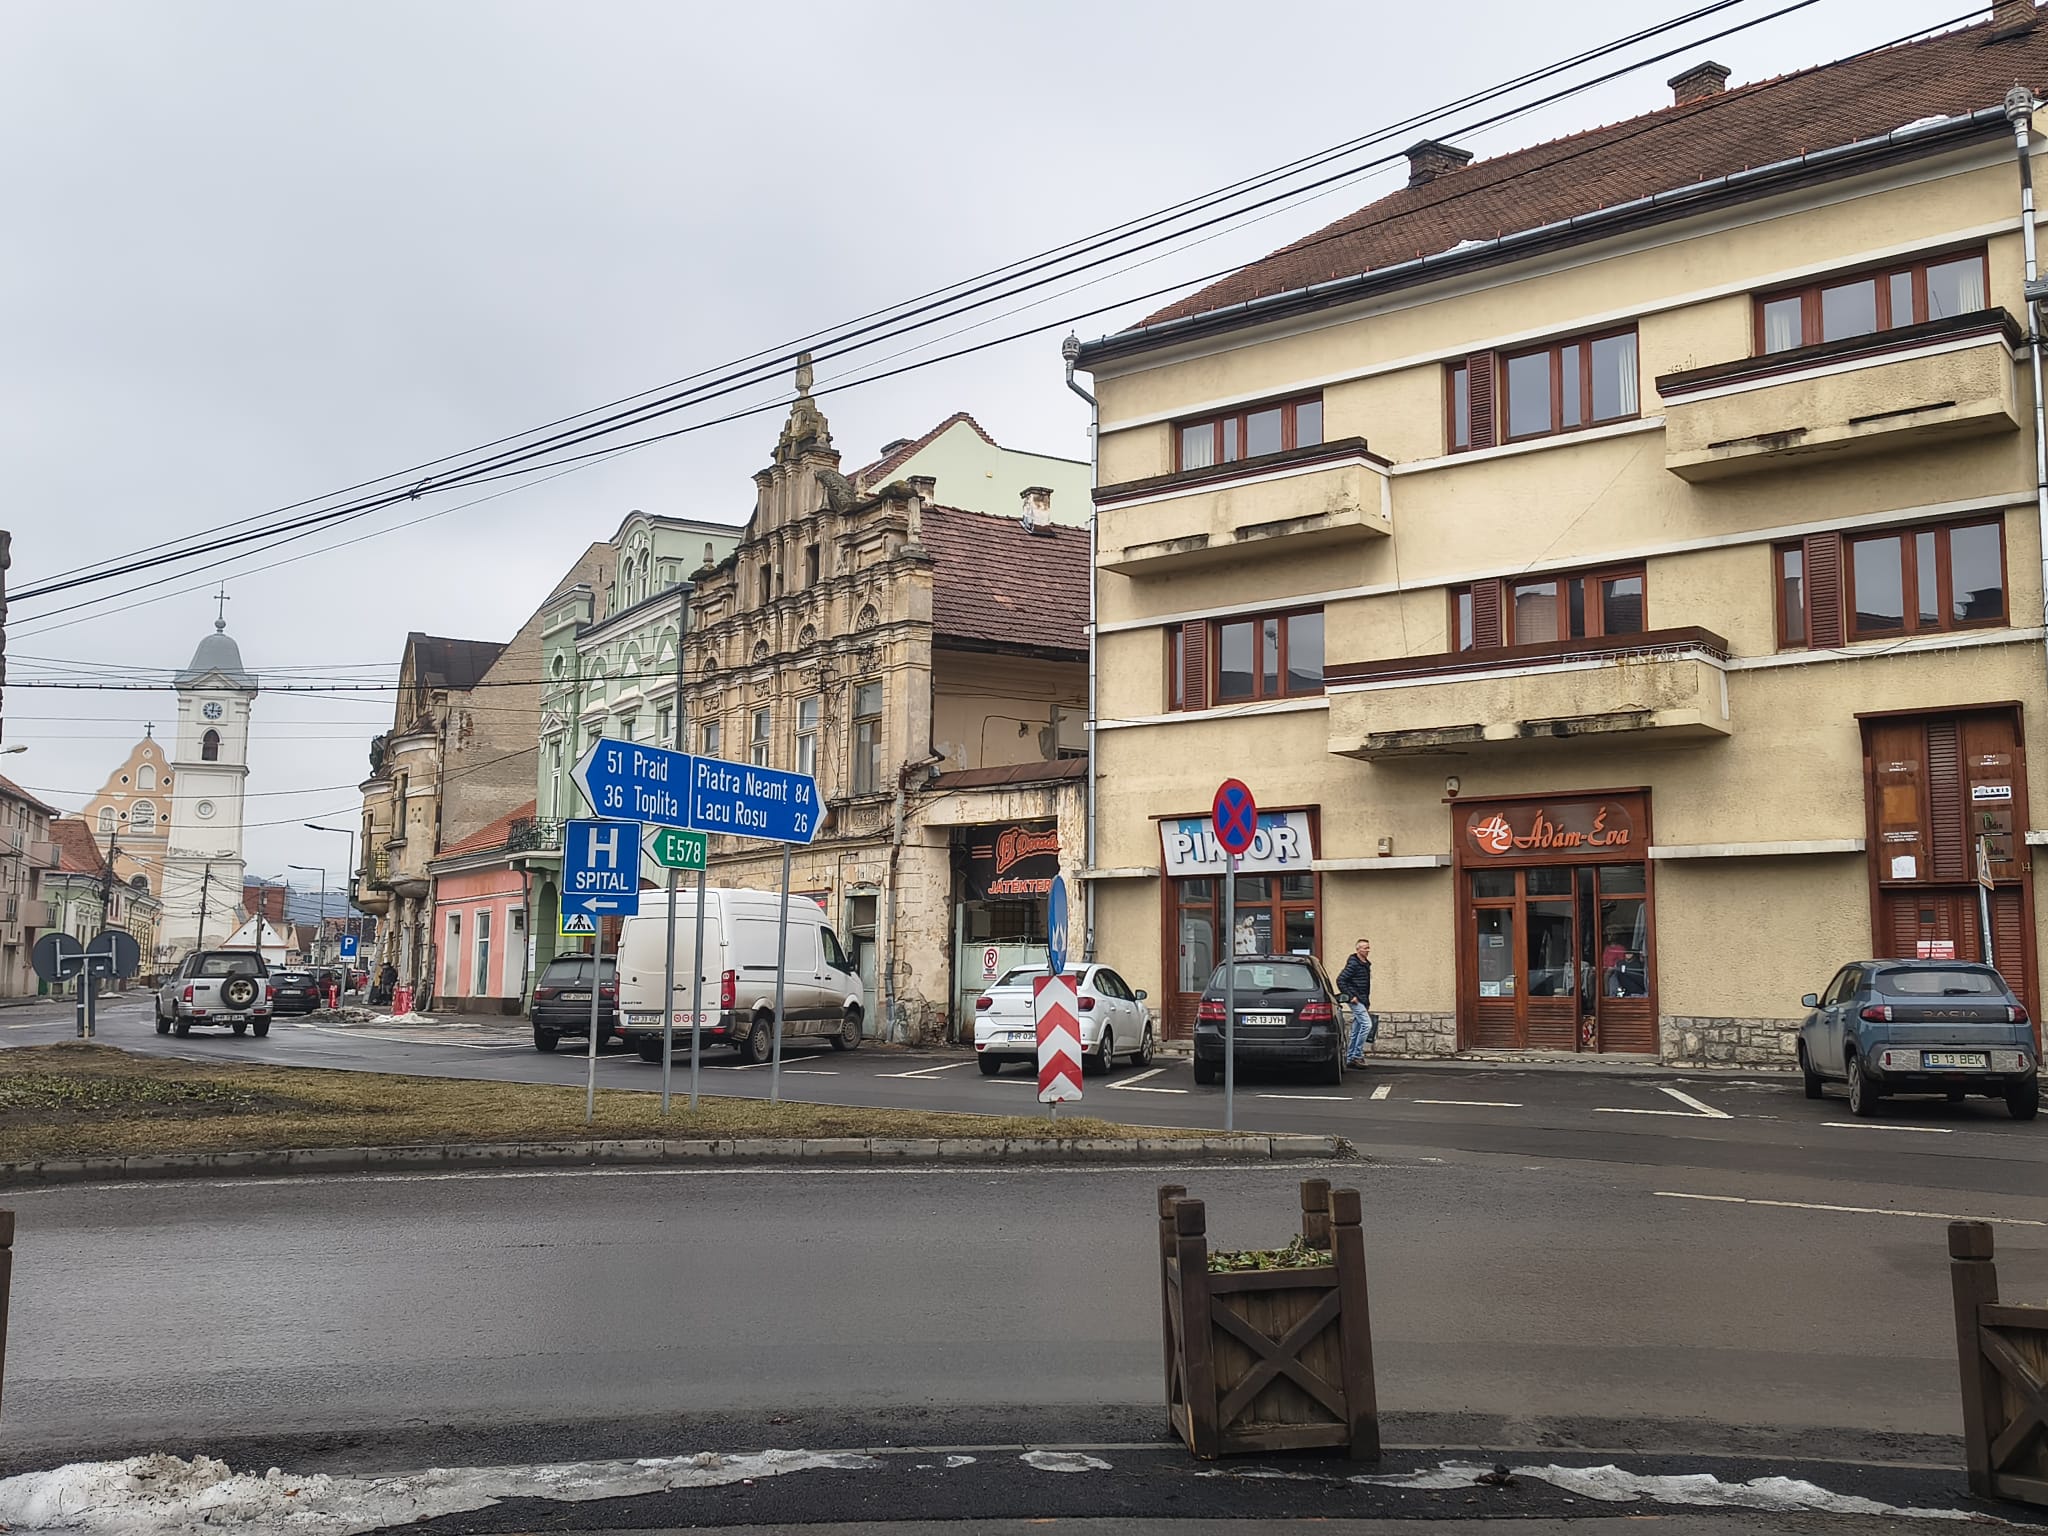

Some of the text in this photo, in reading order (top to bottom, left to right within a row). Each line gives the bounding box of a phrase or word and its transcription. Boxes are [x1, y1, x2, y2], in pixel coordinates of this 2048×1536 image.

[607, 750, 669, 782] 51 Praid
[697, 763, 810, 805] Piatra Neamț 84
[604, 784, 678, 821] 36 Toplița
[696, 794, 808, 833] Lacu Roșu 26
[1513, 806, 1630, 848] Ádám-Éva
[587, 827, 619, 869] H
[666, 834, 701, 864] E578
[1171, 827, 1300, 864] PIKOR
[575, 871, 629, 891] SPITAL
[345, 937, 354, 950] P
[1245, 1016, 1284, 1024] HR 13 JYH
[1922, 1010, 1979, 1018] DACIA
[1931, 1054, 1983, 1065] B 13 BEK
